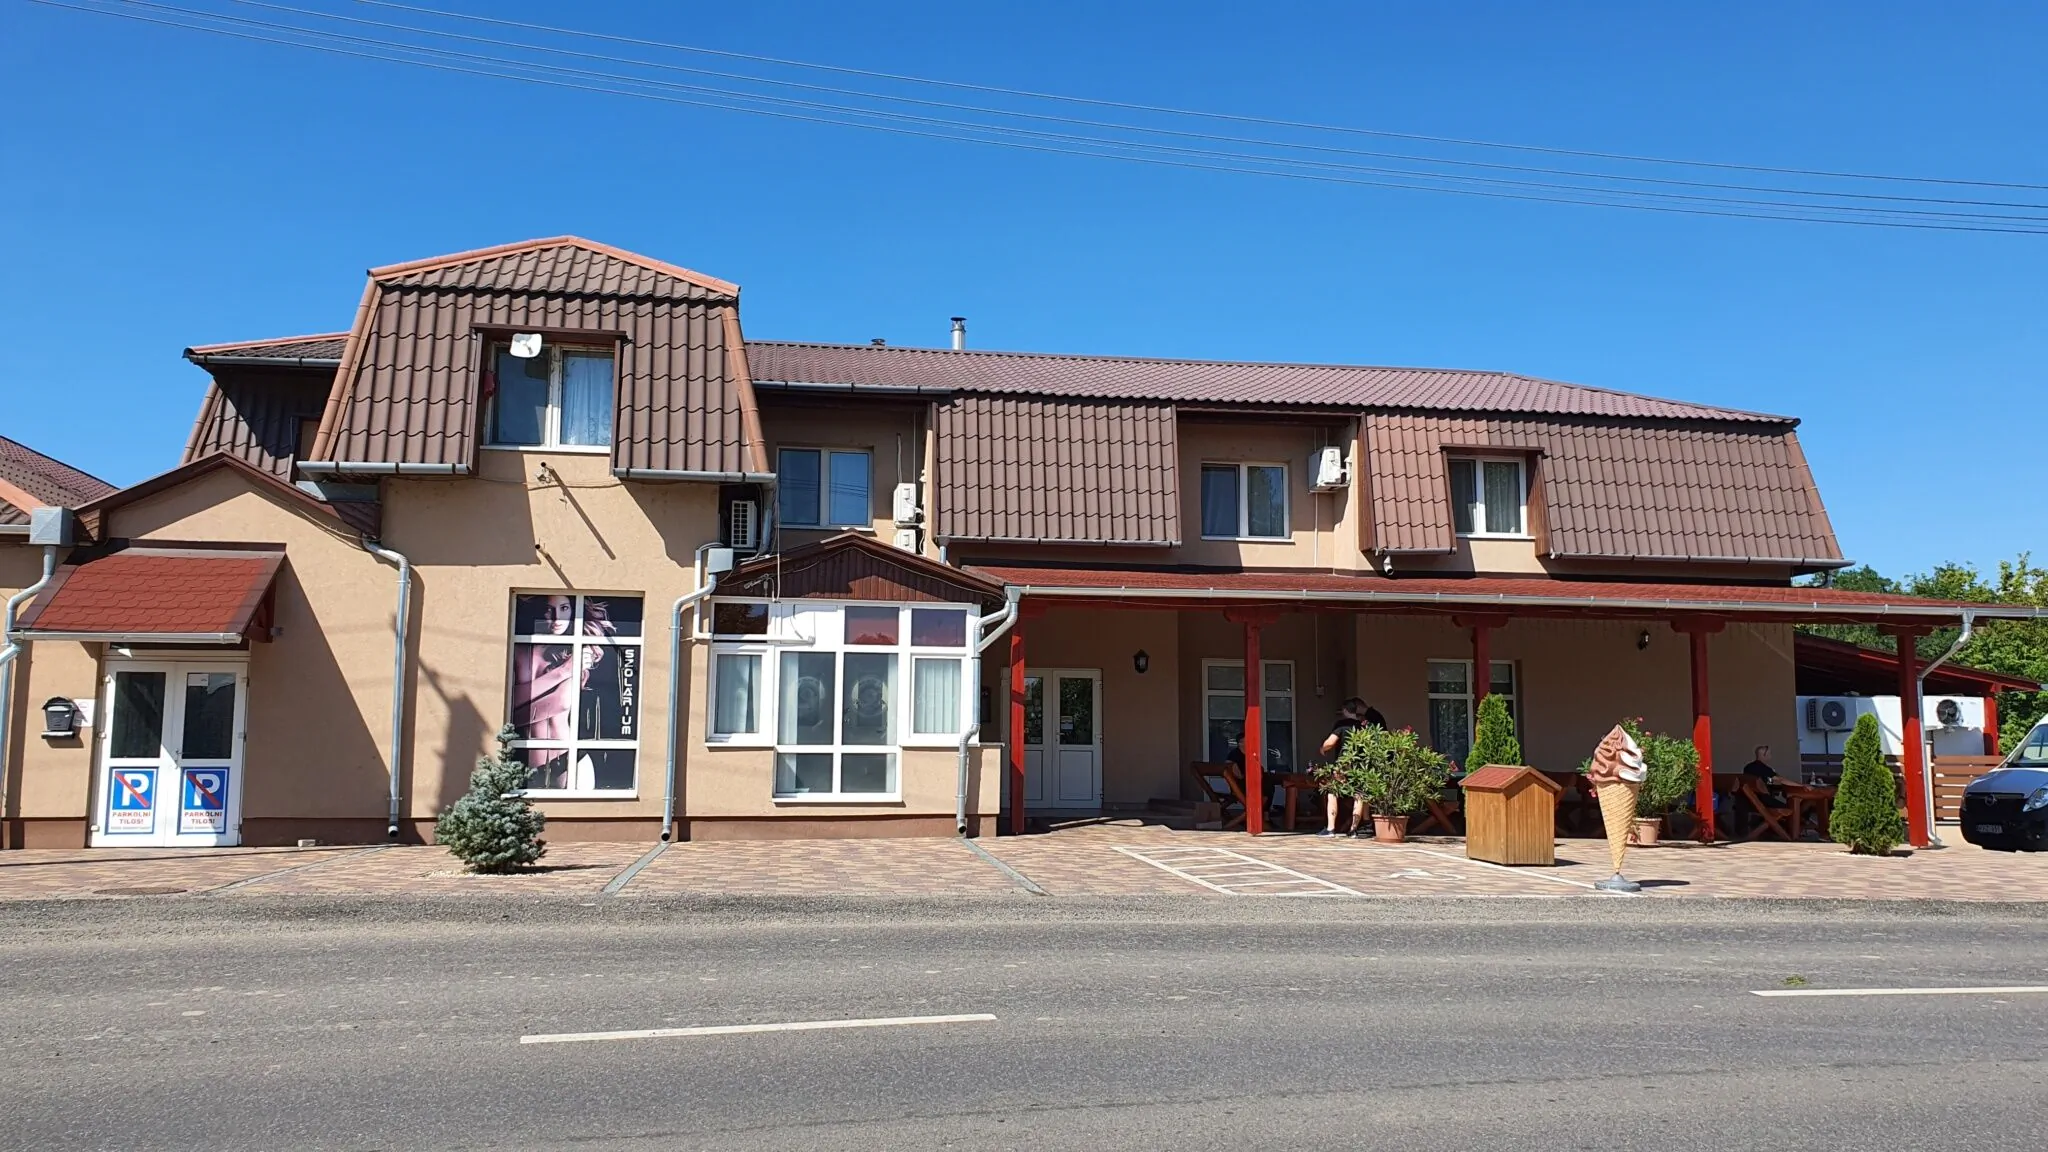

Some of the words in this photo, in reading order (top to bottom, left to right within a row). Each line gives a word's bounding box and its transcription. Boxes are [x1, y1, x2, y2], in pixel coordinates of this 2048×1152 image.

[621, 649, 635, 735] SZOLÁRIUM
[122, 773, 149, 806] P
[193, 773, 220, 806] P
